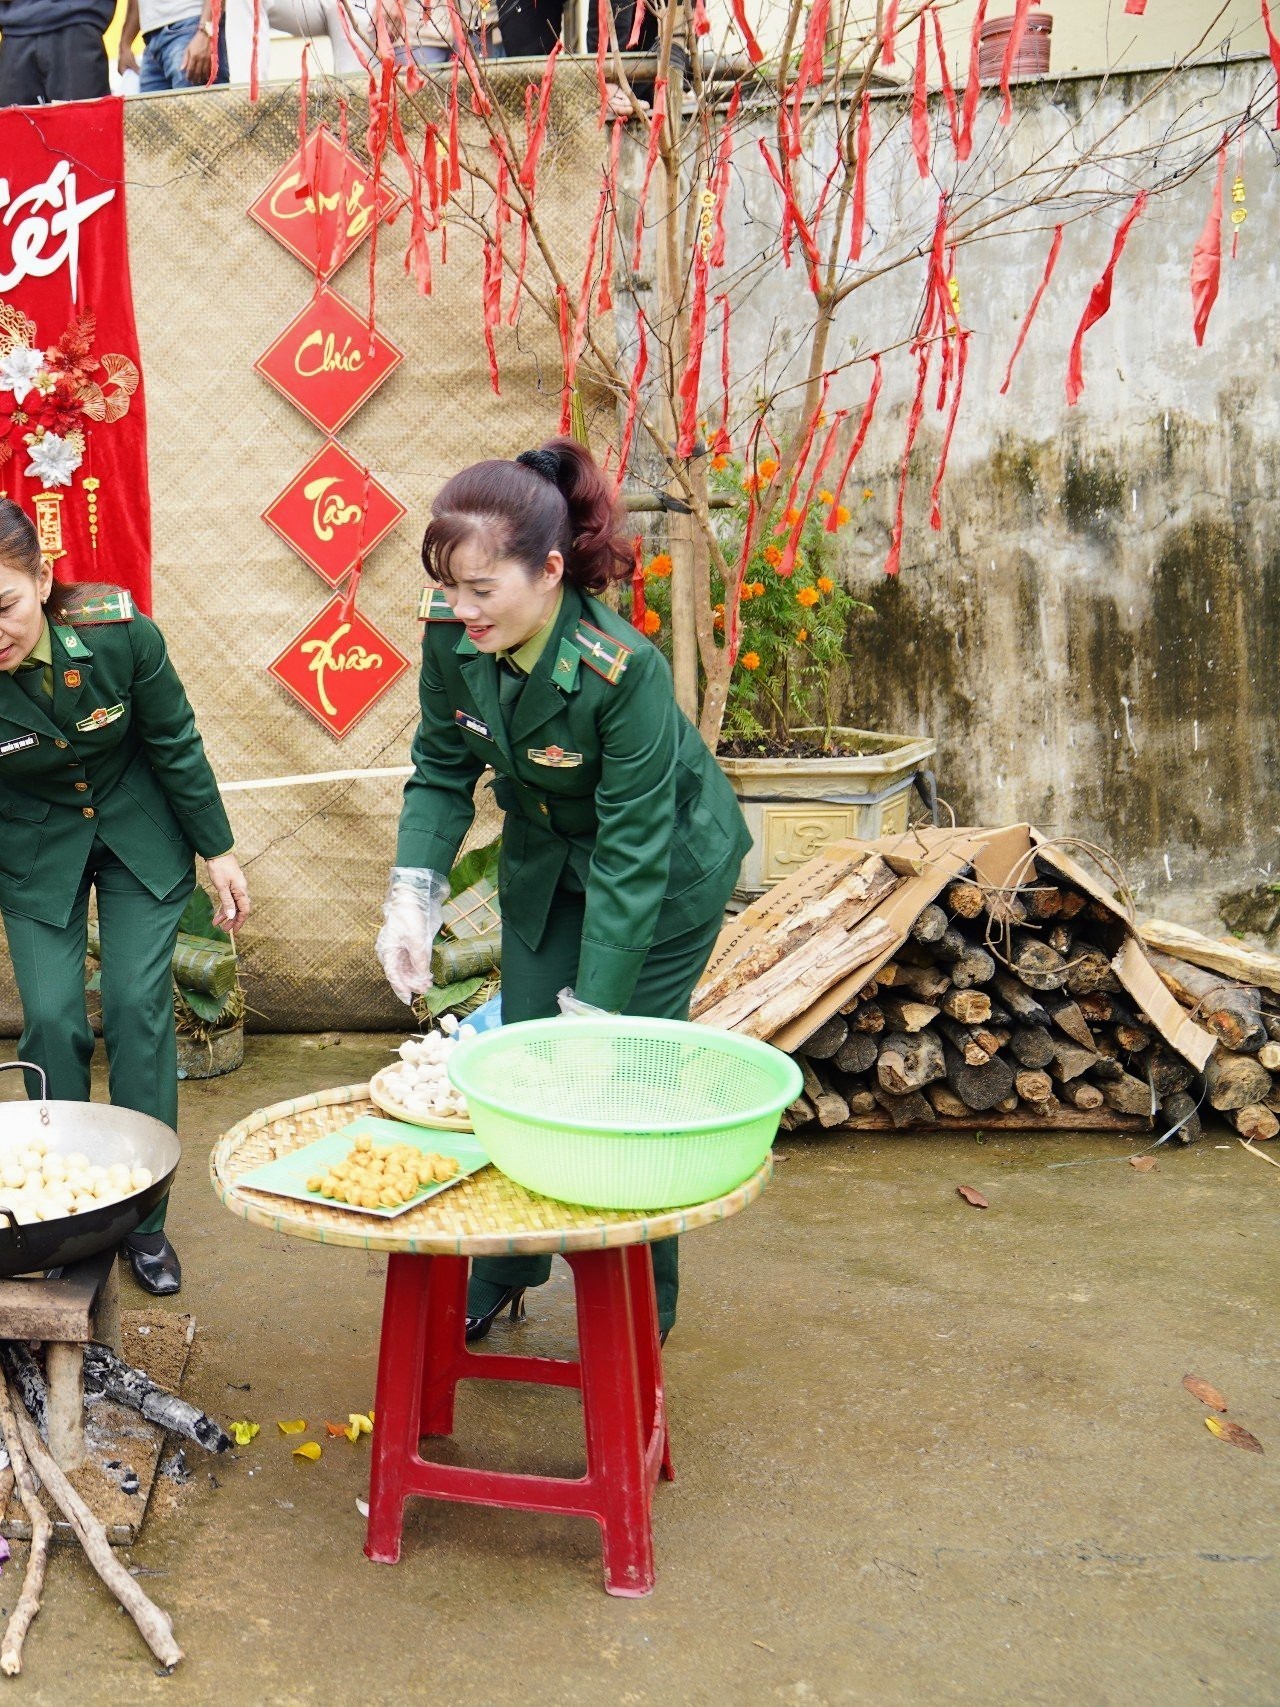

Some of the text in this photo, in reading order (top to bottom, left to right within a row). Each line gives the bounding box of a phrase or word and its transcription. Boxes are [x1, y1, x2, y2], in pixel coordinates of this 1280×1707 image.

[295, 329, 365, 377] Chúc
[303, 476, 361, 542] Tân
[300, 623, 382, 716] Xuân
[706, 862, 833, 974] HANDLE WITH CARE
